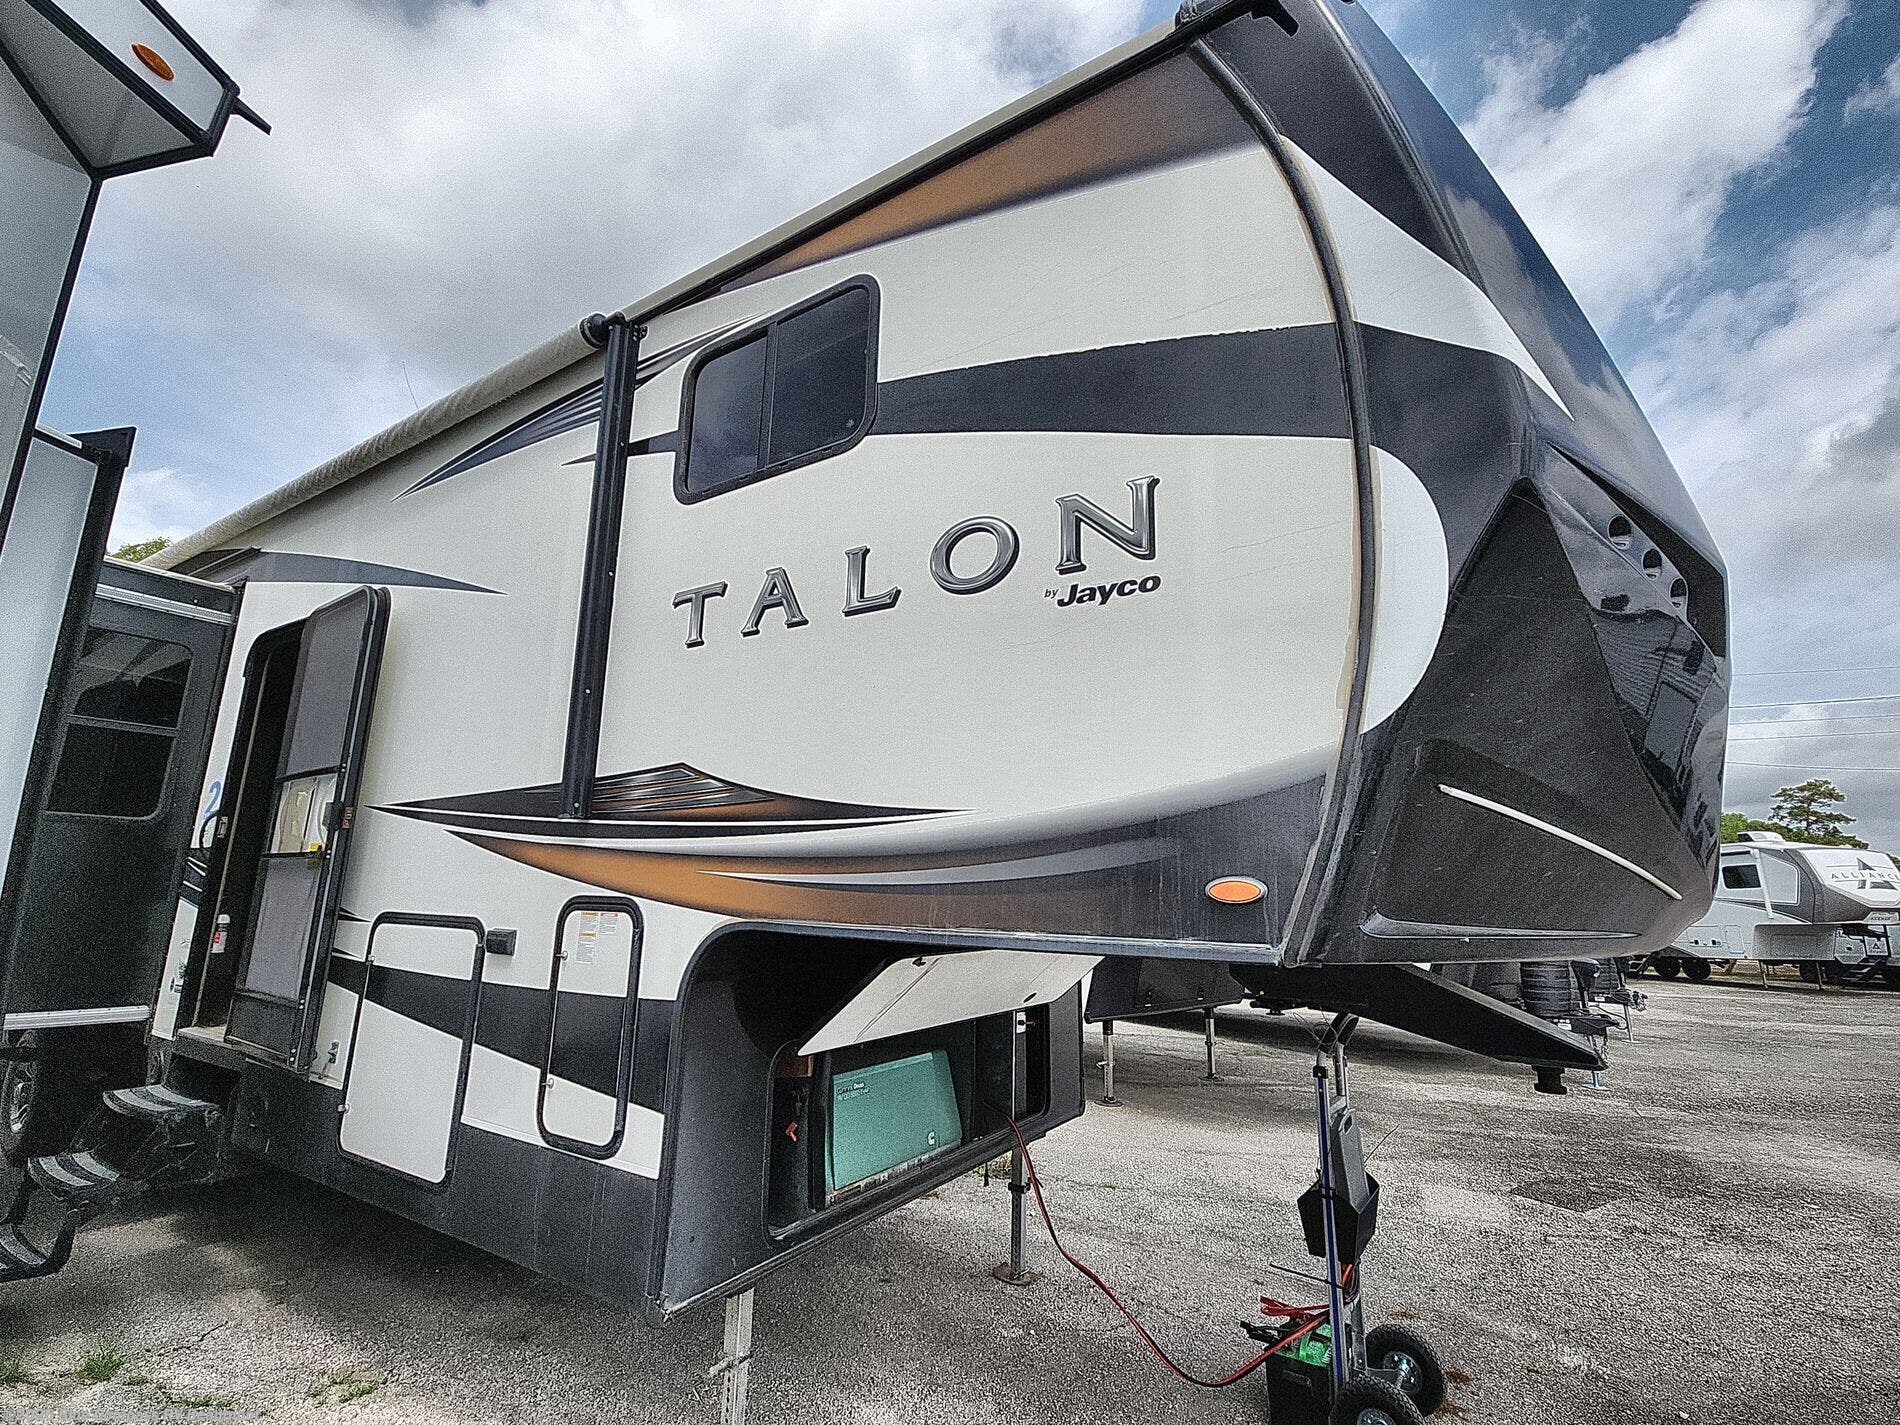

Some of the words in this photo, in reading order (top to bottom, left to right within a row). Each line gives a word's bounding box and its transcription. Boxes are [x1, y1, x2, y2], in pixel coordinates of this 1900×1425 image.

[673, 475, 1161, 647] TALON
[1044, 589, 1059, 599] by
[1057, 576, 1161, 607] Jayco
